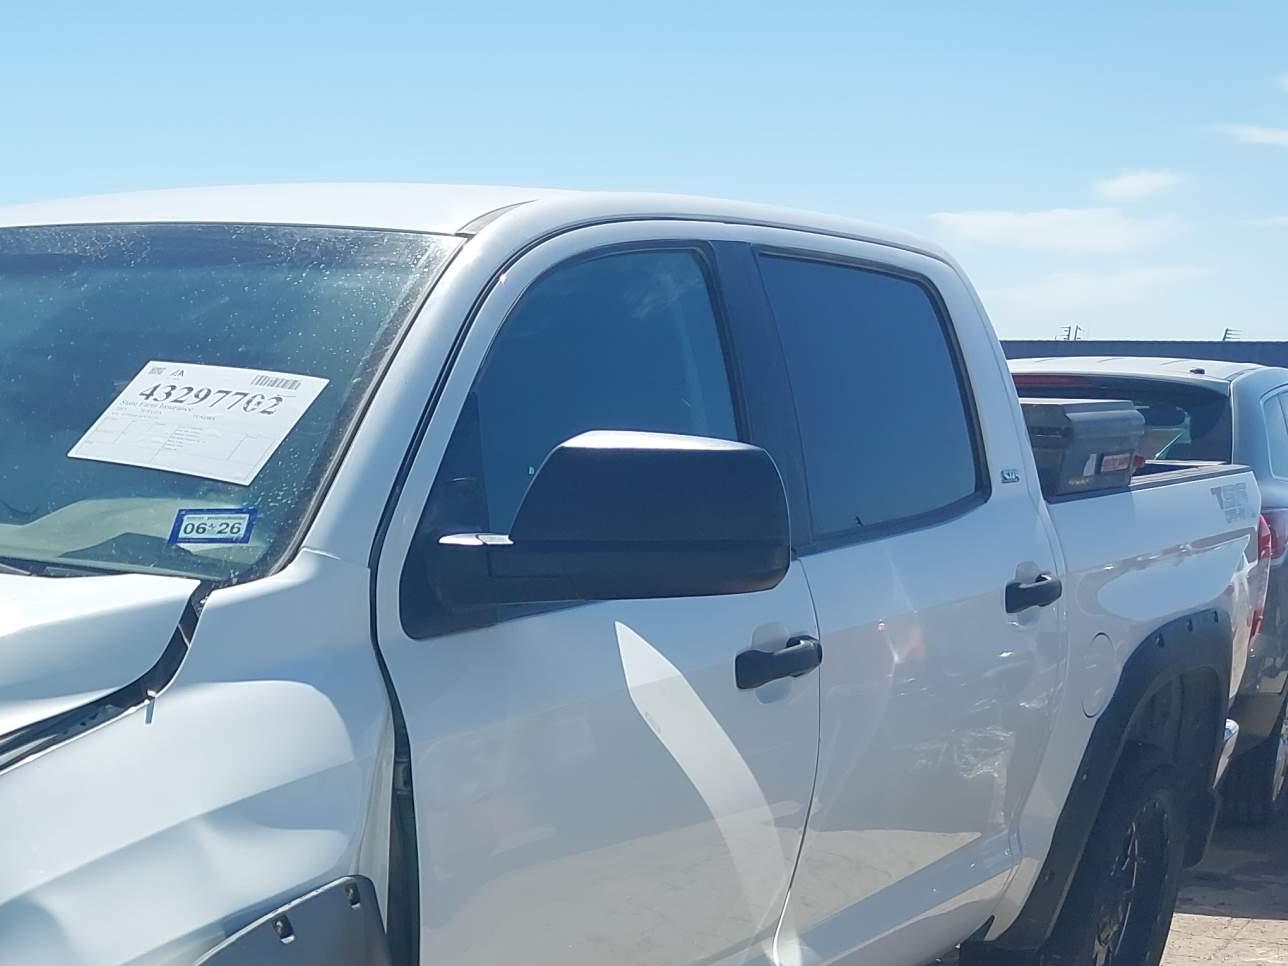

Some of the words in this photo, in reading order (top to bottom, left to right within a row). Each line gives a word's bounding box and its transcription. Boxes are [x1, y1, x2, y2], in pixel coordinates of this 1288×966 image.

[139, 383, 283, 415] 43297702
[183, 522, 208, 535] 06
[216, 522, 242, 535] 26
